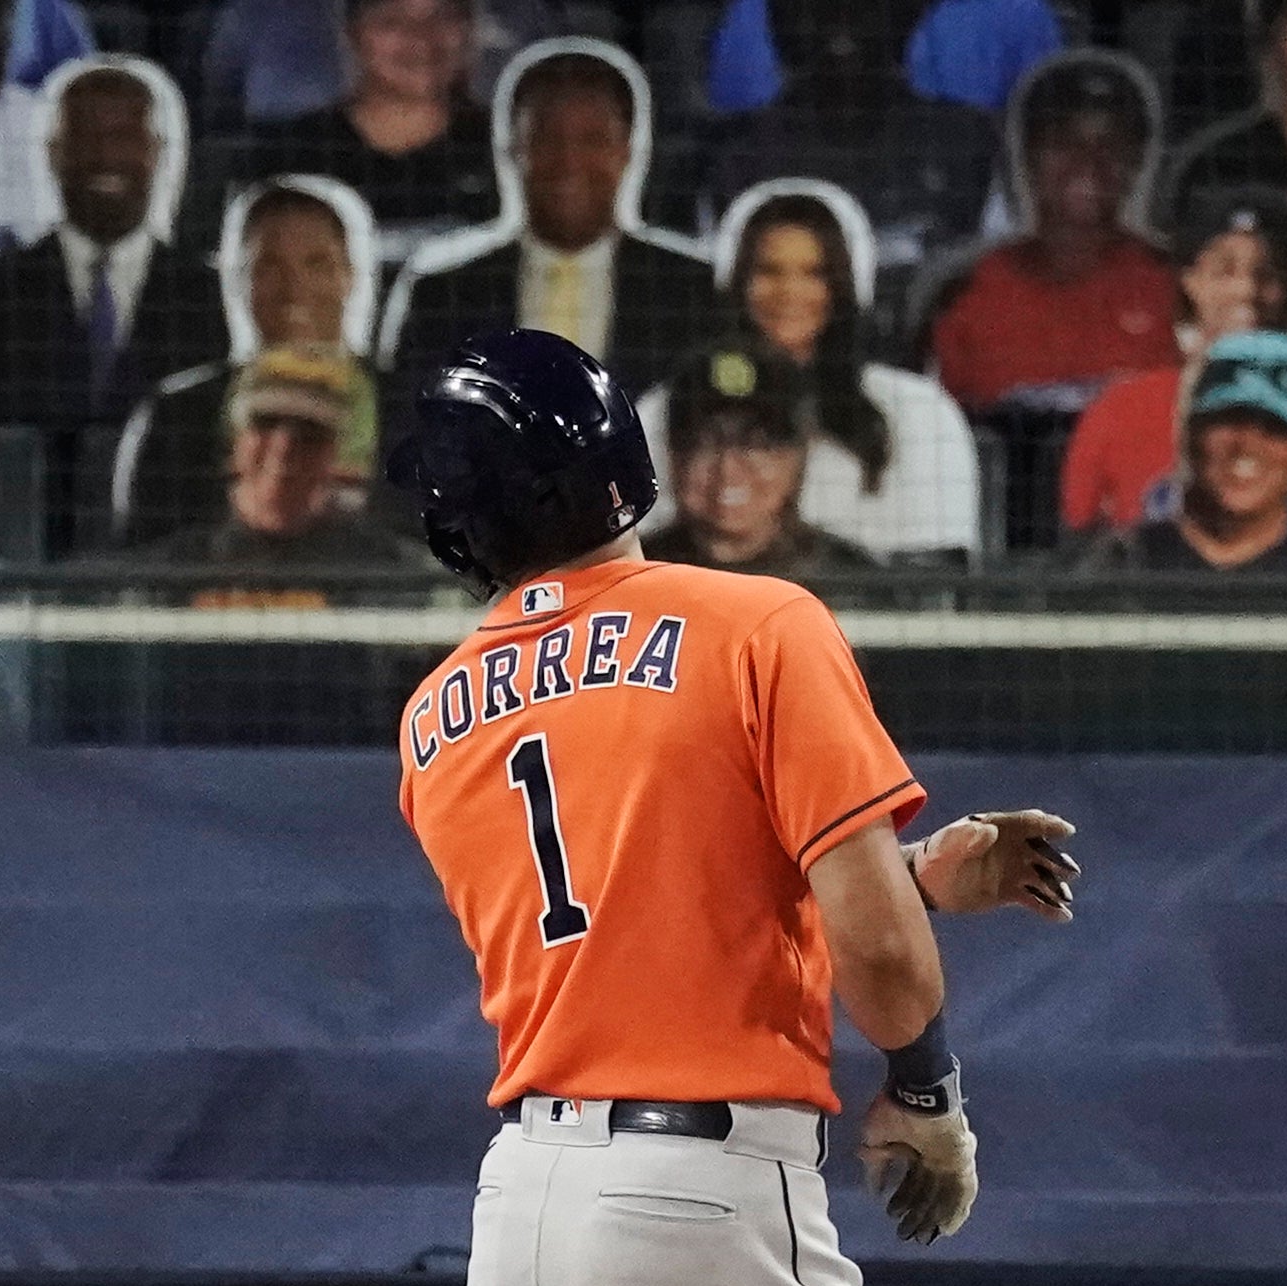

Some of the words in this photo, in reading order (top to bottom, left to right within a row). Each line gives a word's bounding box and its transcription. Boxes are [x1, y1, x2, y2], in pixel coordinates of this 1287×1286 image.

[608, 481, 623, 508] 1
[409, 611, 686, 771] CORREA
[505, 731, 591, 949] 1
